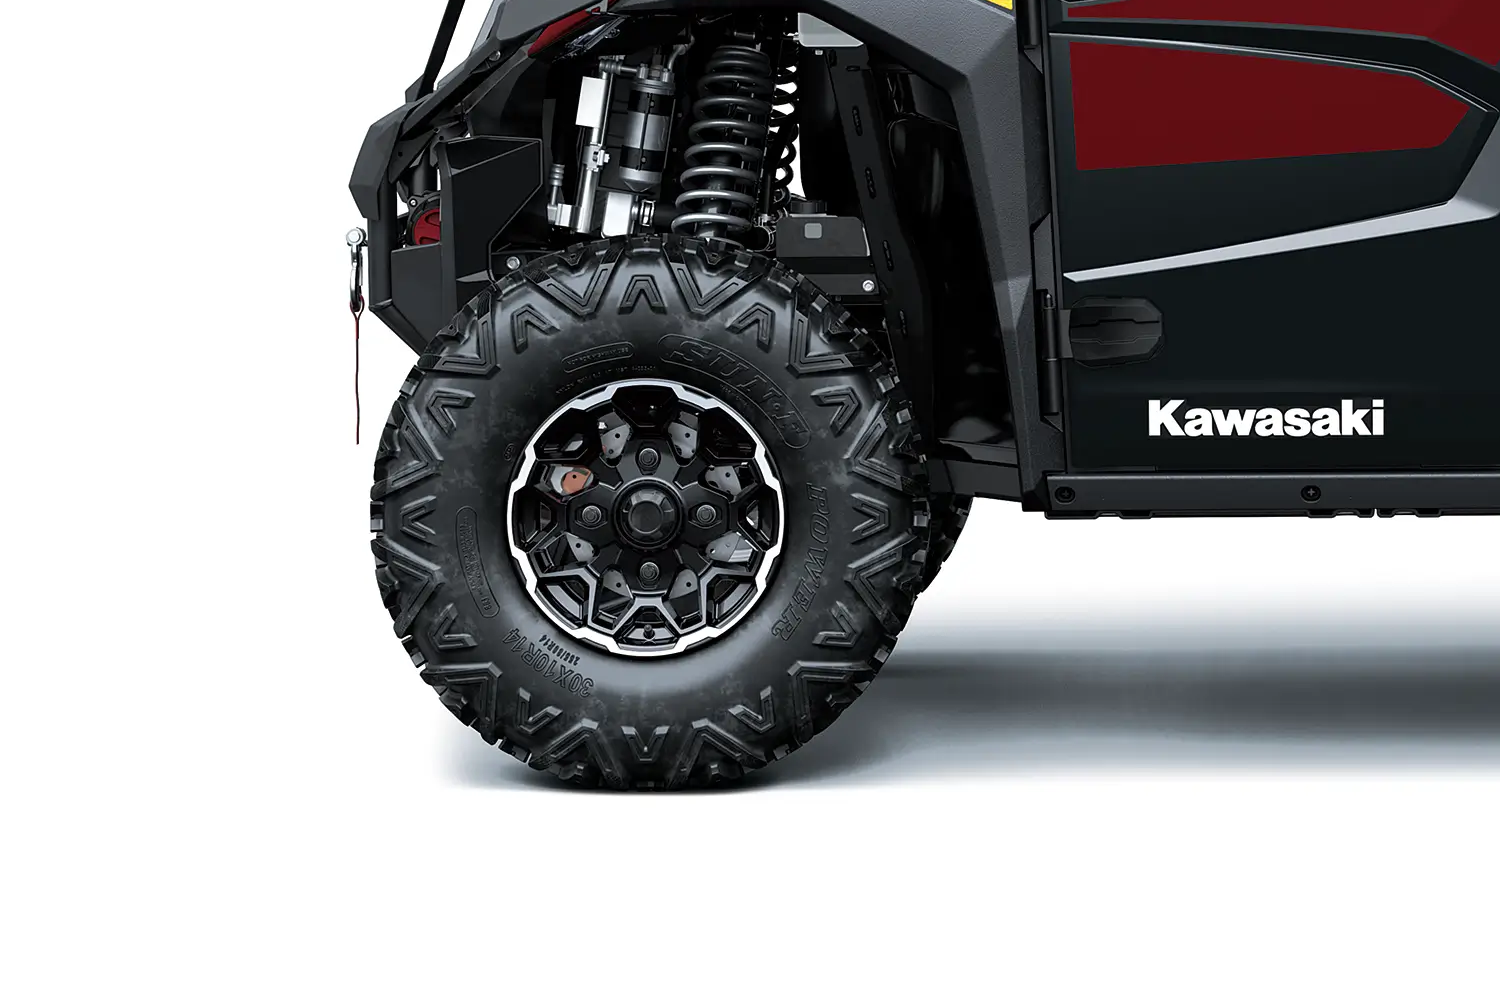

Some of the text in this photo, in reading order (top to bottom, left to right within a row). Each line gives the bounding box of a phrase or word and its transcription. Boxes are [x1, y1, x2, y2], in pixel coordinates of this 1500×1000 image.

[1148, 399, 1384, 437] Kawasaki
[771, 482, 831, 642] POWER
[502, 628, 594, 698] 30X10R14
